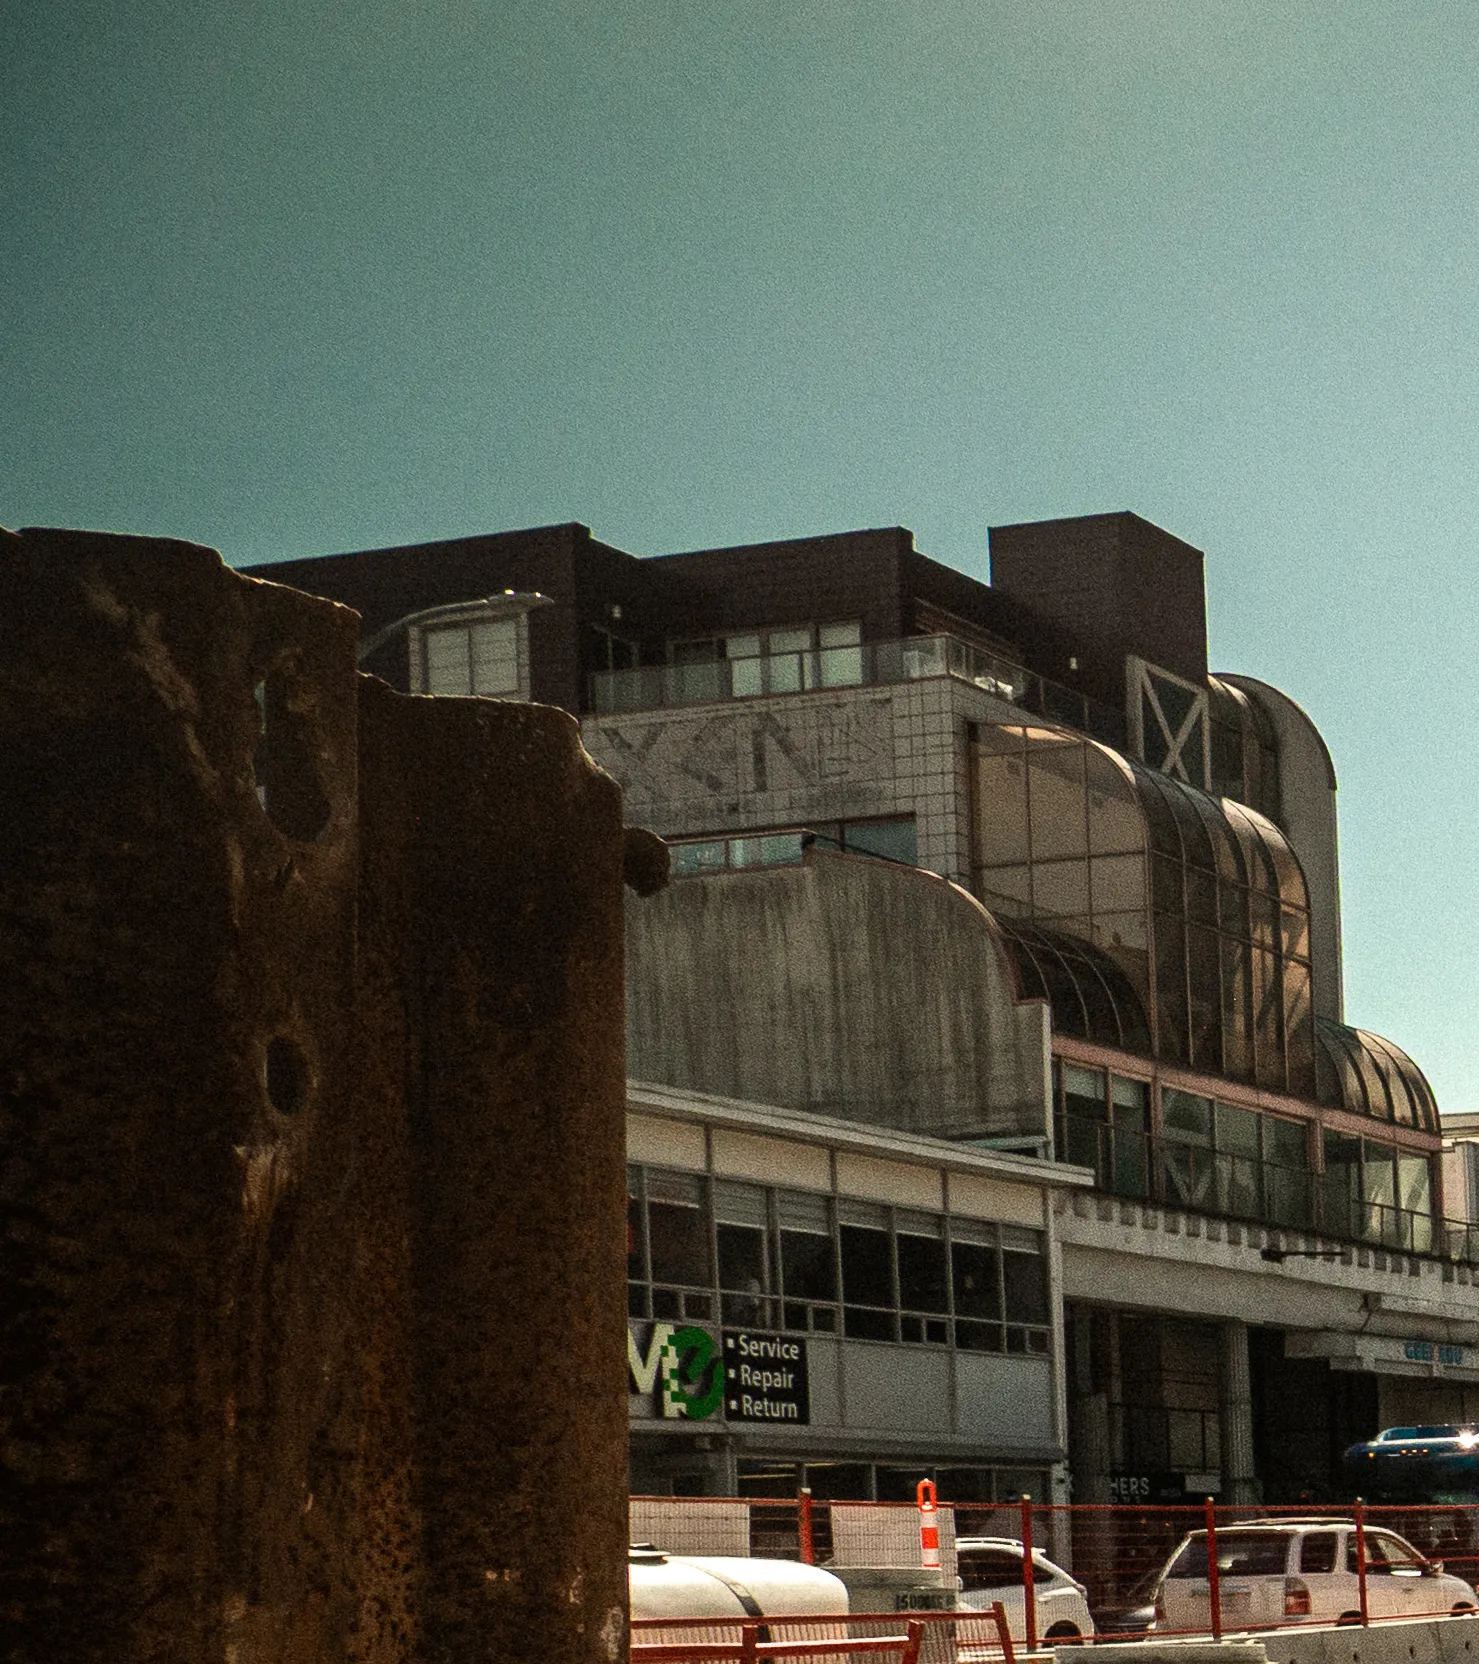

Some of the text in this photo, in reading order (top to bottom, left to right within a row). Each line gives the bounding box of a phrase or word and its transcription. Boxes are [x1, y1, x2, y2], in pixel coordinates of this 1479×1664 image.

[739, 1335, 799, 1360] Service
[741, 1364, 794, 1392] Repair
[743, 1395, 798, 1418] Return
